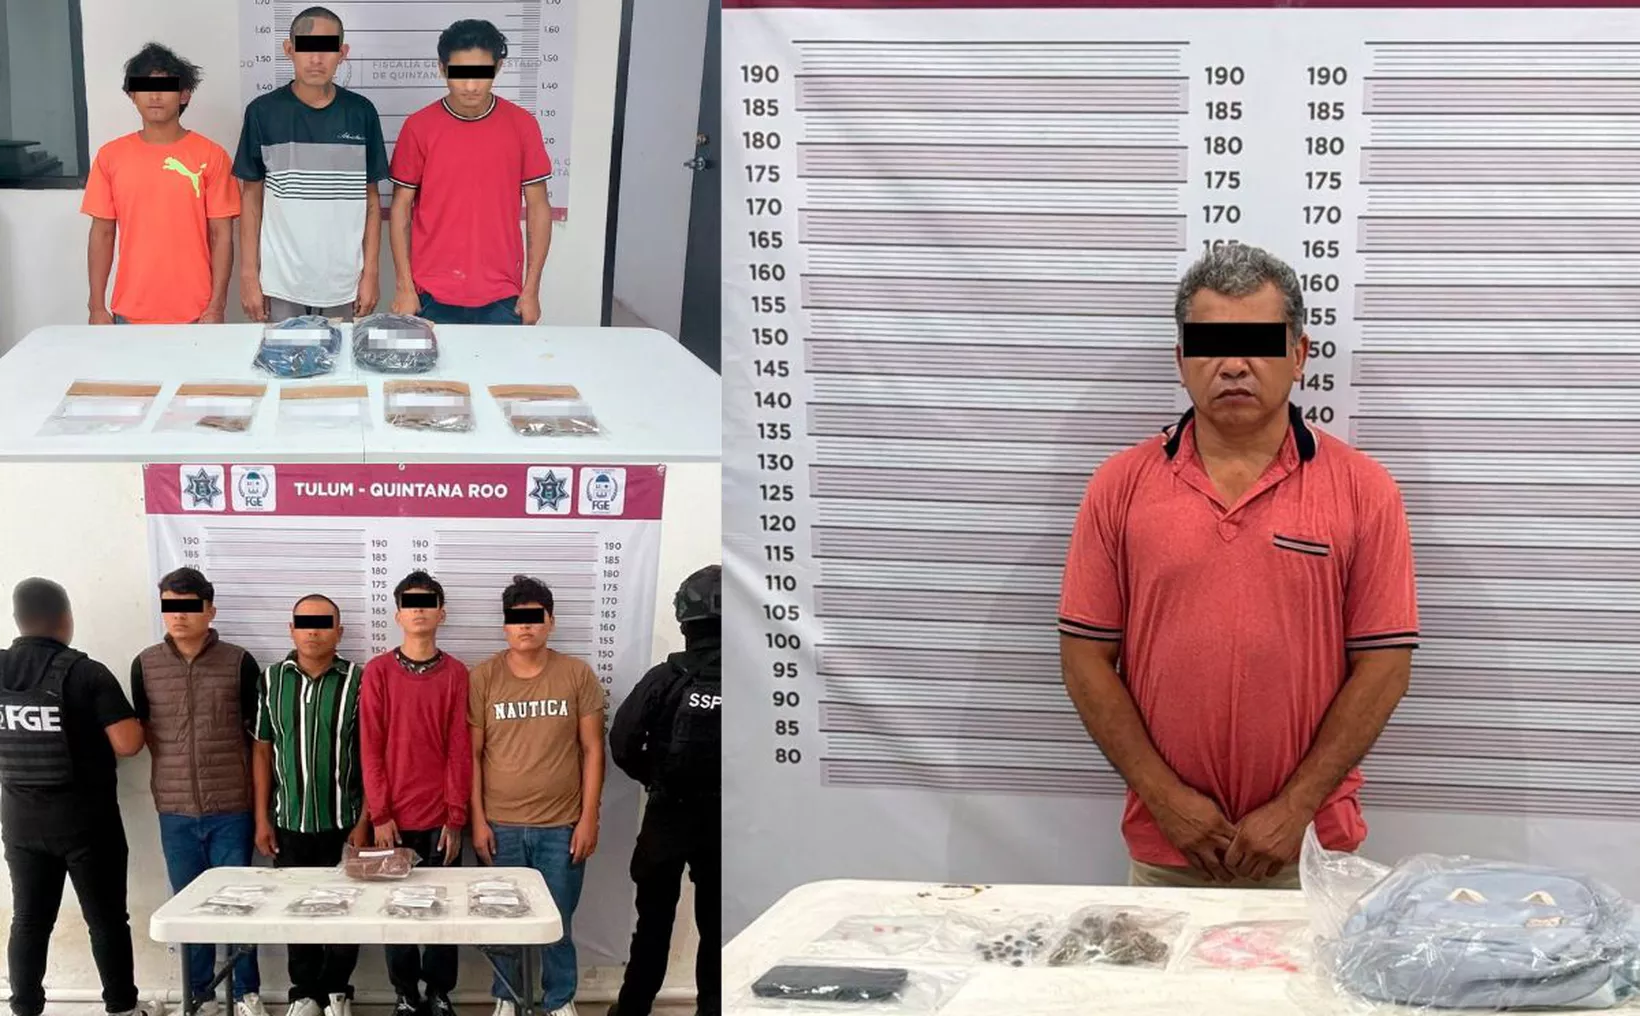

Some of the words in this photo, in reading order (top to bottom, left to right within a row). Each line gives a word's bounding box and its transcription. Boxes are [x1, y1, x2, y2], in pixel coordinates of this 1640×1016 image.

[373, 71, 387, 79] DE
[389, 71, 443, 80] QUINTAN
[741, 65, 779, 83] 190
[1205, 66, 1245, 85] 190
[1307, 66, 1347, 85] 190
[743, 98, 779, 116] 185
[1206, 101, 1242, 120] 185
[1307, 102, 1344, 121] 185
[743, 132, 781, 150] 180
[1204, 136, 1243, 155] 180
[1305, 137, 1344, 155] 180
[745, 165, 780, 183] 175
[1204, 171, 1240, 189] 175
[1305, 171, 1341, 190] 175
[746, 198, 782, 216] 170
[1203, 205, 1241, 224] 170
[1303, 206, 1341, 224] 170
[749, 231, 783, 249] 165
[1302, 240, 1339, 258] 165
[749, 264, 785, 281] 160
[1300, 274, 1339, 292] 160
[751, 296, 786, 313] 155
[1303, 307, 1336, 325] 155
[752, 328, 788, 346] 150
[1308, 341, 1336, 359] 50
[754, 360, 789, 377] 145
[1300, 373, 1334, 391] 145
[754, 391, 791, 409] 140
[757, 423, 791, 440] 135
[757, 454, 793, 471] 130
[294, 482, 354, 496] TULUM
[370, 483, 463, 498] QUINTANA
[468, 483, 509, 498] ROO
[760, 484, 794, 501] 125
[245, 496, 263, 507] FGE
[592, 500, 610, 510] FGE
[760, 515, 796, 532] 120
[183, 536, 200, 545] 190
[371, 540, 388, 548] 190
[412, 540, 429, 548] 190
[604, 542, 621, 550] 190
[184, 550, 200, 558] 185
[371, 553, 388, 561] 185
[412, 554, 428, 562] 185
[604, 556, 620, 564] 185
[765, 545, 794, 562] 115
[371, 567, 388, 575] 180
[603, 570, 619, 578] 180
[371, 581, 387, 589] 175
[602, 583, 618, 591] 175
[765, 575, 796, 591] 110
[371, 594, 388, 602] 170
[601, 597, 617, 605] 170
[371, 607, 387, 615] 165
[600, 610, 616, 618] 165
[763, 605, 799, 621] 105
[371, 620, 387, 628] 160
[371, 633, 387, 641] 155
[765, 633, 801, 650] 100
[598, 650, 614, 658] 150
[773, 662, 798, 678] 95
[773, 691, 800, 707] 90
[5, 705, 61, 731] FGE
[494, 700, 568, 719] NAUTICA
[775, 720, 799, 736] 85
[776, 748, 801, 764] 80
